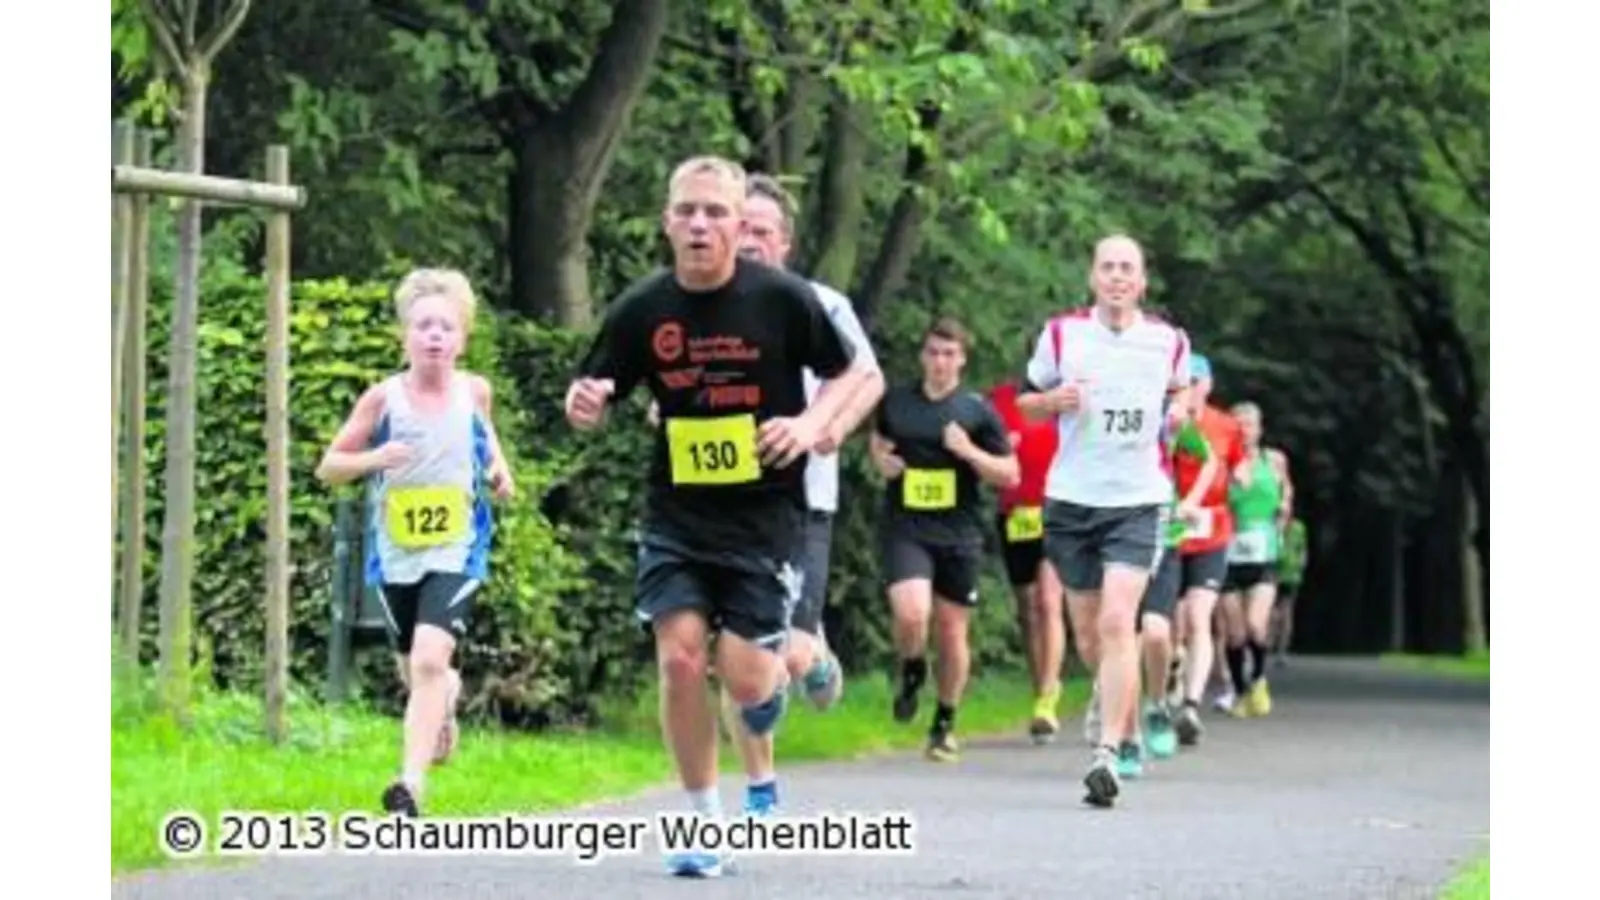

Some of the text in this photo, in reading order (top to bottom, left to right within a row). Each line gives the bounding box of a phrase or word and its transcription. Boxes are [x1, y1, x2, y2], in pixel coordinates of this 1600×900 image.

[1102, 409, 1143, 435] 738
[689, 440, 738, 471] 130
[404, 505, 449, 535] 122
